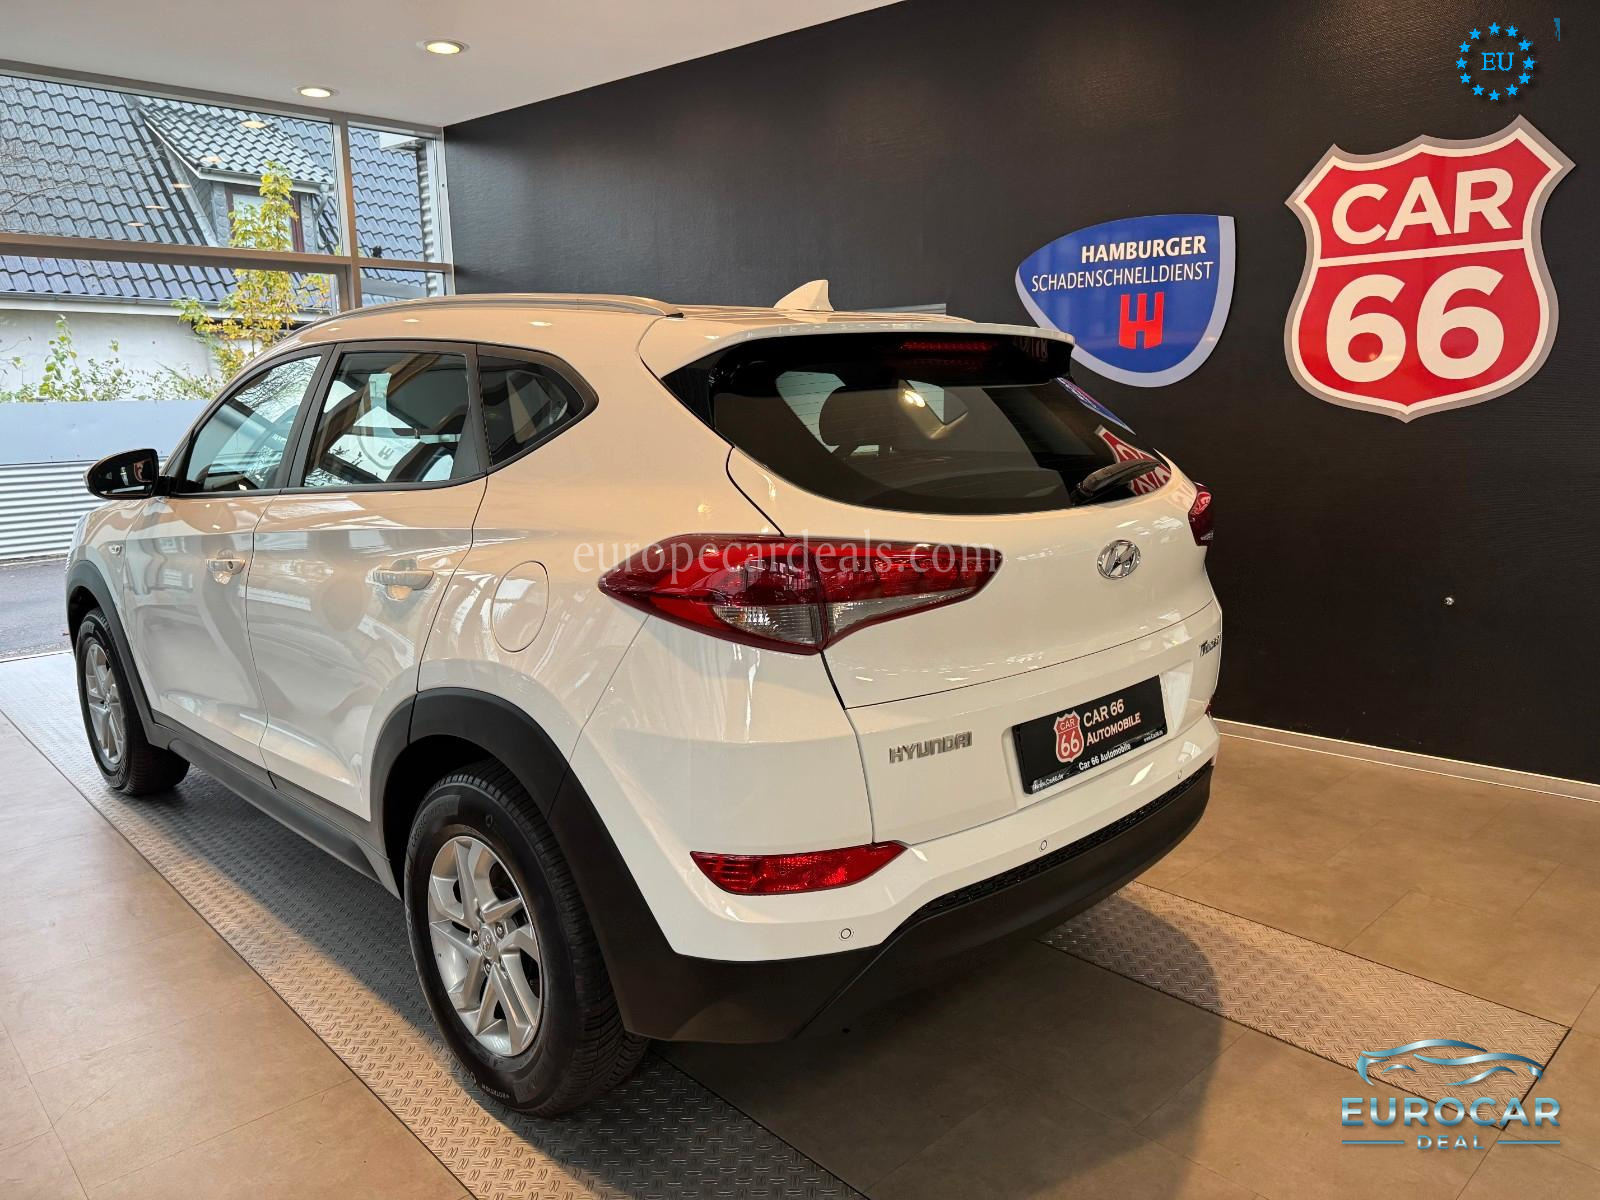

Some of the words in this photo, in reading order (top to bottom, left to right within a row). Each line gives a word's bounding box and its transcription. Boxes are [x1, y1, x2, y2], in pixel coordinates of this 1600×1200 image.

[1331, 167, 1514, 246] CAR
[1080, 235, 1207, 264] HAMBURGER
[1031, 261, 1214, 293] SCHADENSCHNELLDIENST
[1326, 265, 1505, 383] 66
[1059, 717, 1076, 731] CAR
[1083, 705, 1110, 727] CAR
[1110, 698, 1125, 717] 66
[1060, 733, 1081, 756] 66
[1086, 712, 1142, 747] AUTOMOBILE
[889, 731, 973, 765] HYUNDAI
[1078, 758, 1091, 772] Car
[1091, 755, 1100, 767] 66
[1100, 742, 1132, 763] Automobile
